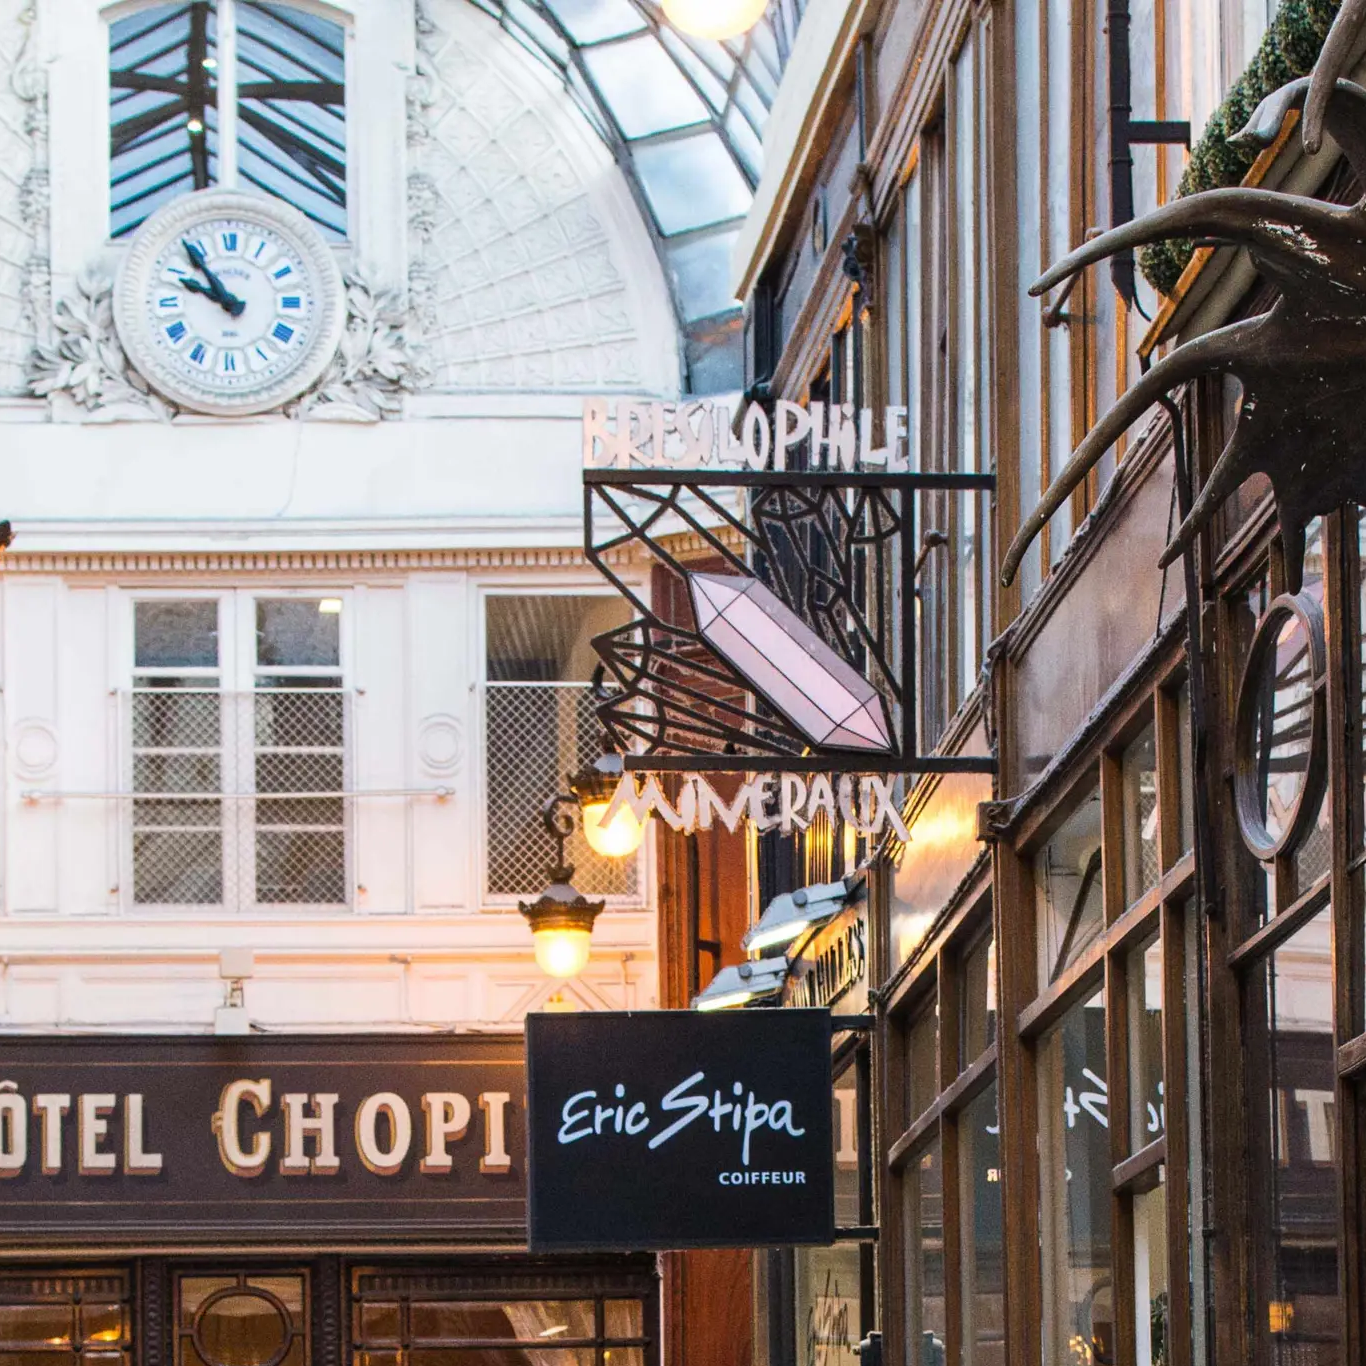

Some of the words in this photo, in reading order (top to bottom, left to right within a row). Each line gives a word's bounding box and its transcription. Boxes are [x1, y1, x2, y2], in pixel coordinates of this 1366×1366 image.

[212, 1076, 519, 1180] CHOPI
[557, 1083, 650, 1145] Eric
[648, 1070, 806, 1166] Stipa
[718, 1171, 807, 1186] COIFFEUR
